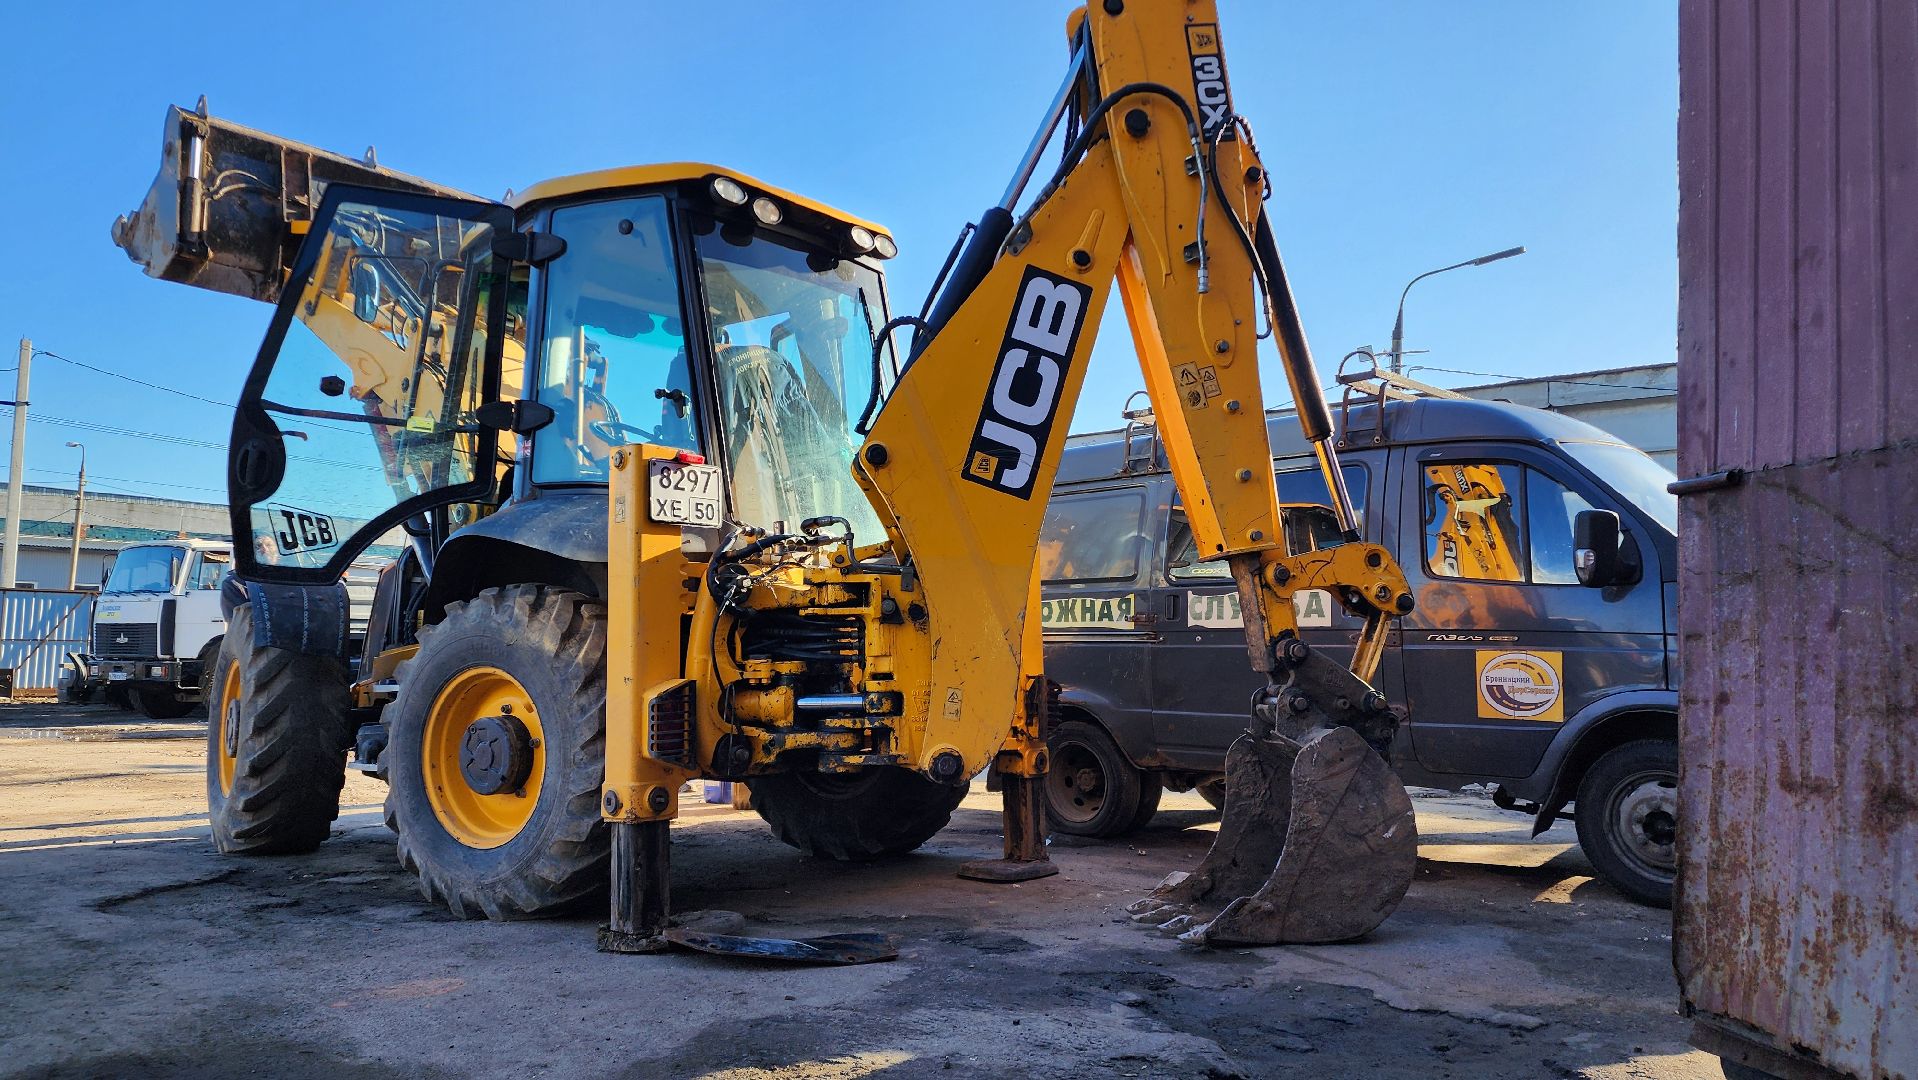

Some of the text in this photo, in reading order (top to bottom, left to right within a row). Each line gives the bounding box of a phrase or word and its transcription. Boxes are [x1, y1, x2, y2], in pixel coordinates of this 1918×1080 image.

[1193, 56, 1228, 130] 3CX
[980, 276, 1082, 490] JCB
[658, 466, 713, 493] 8297
[976, 457, 990, 474] JCB
[695, 502, 715, 521] 50
[279, 509, 333, 550] JCB
[1190, 591, 1325, 621] СЛУА
